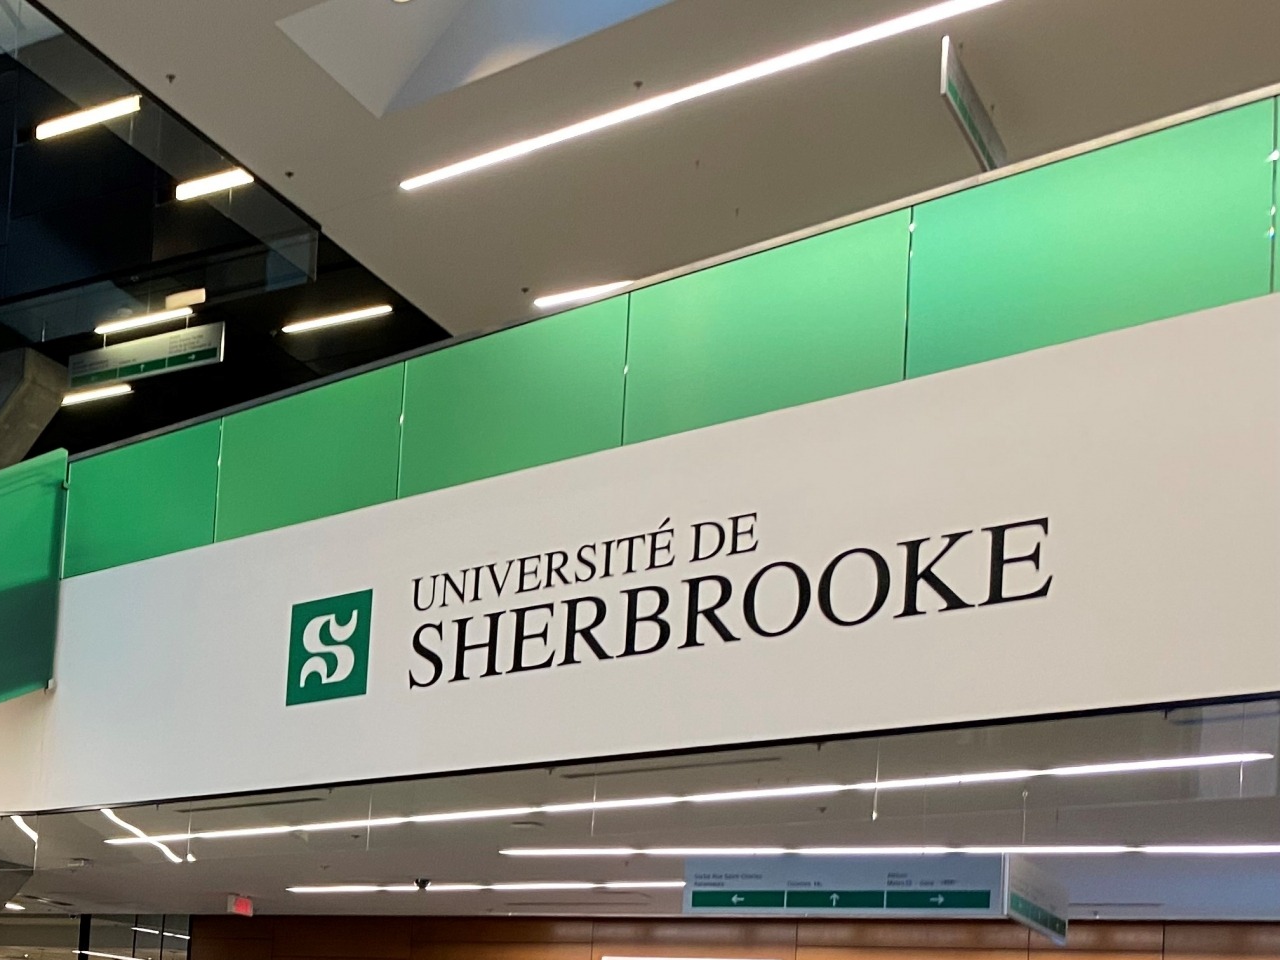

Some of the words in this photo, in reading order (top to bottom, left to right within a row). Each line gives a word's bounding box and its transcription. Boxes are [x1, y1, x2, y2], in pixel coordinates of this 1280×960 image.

[408, 516, 1054, 690] SHERBROOKE
[412, 517, 675, 611] UNIVERSITÉ
[689, 512, 759, 562] DE
